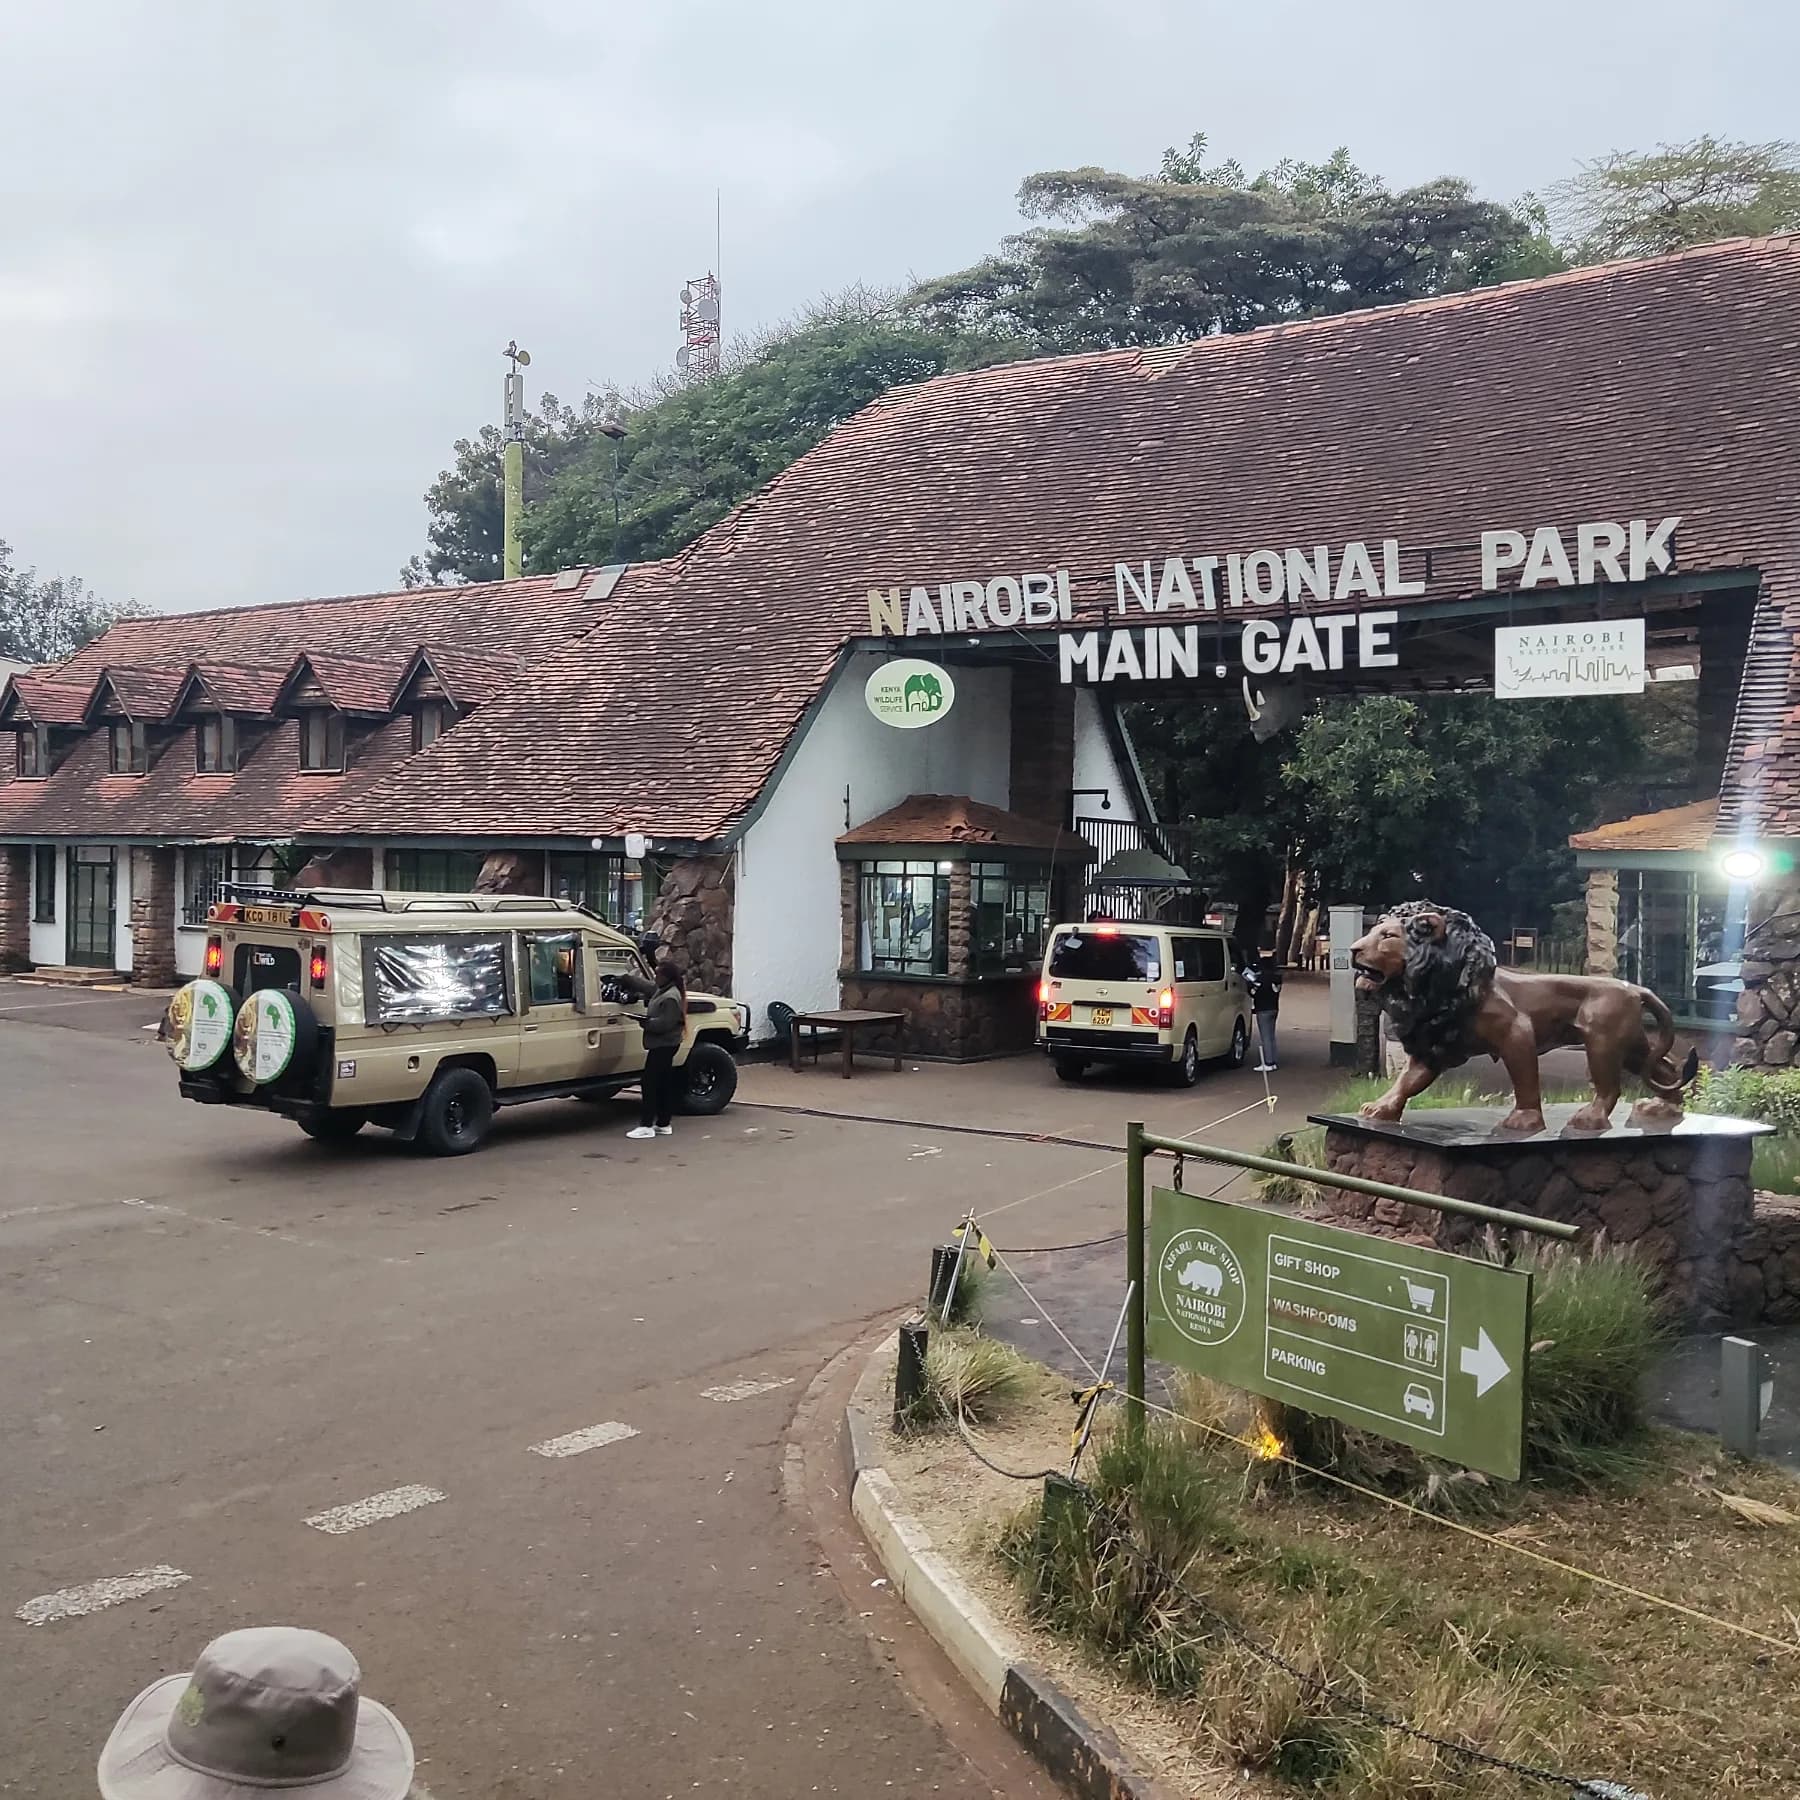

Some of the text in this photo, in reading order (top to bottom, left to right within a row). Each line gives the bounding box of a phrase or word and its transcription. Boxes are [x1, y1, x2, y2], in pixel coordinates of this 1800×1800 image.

[868, 516, 1682, 638] NAIROBI NATIONAL PARK
[1059, 610, 1399, 684] MAIN GATE
[1519, 631, 1624, 647] NAIROBI
[1591, 643, 1625, 653] PARK
[873, 696, 903, 704] WILDLIFE
[880, 705, 904, 713] SERVICE
[1164, 1240, 1241, 1285] KIFARU ARK SHOP
[1273, 1252, 1341, 1280] GIFT SHOP
[1175, 1293, 1227, 1319] NAIROBI
[1176, 1308, 1226, 1329] NATIONAL PARK
[1273, 1297, 1358, 1333] WASHROOMS
[1189, 1321, 1212, 1335] KENYA
[1271, 1347, 1327, 1376] PARKING
